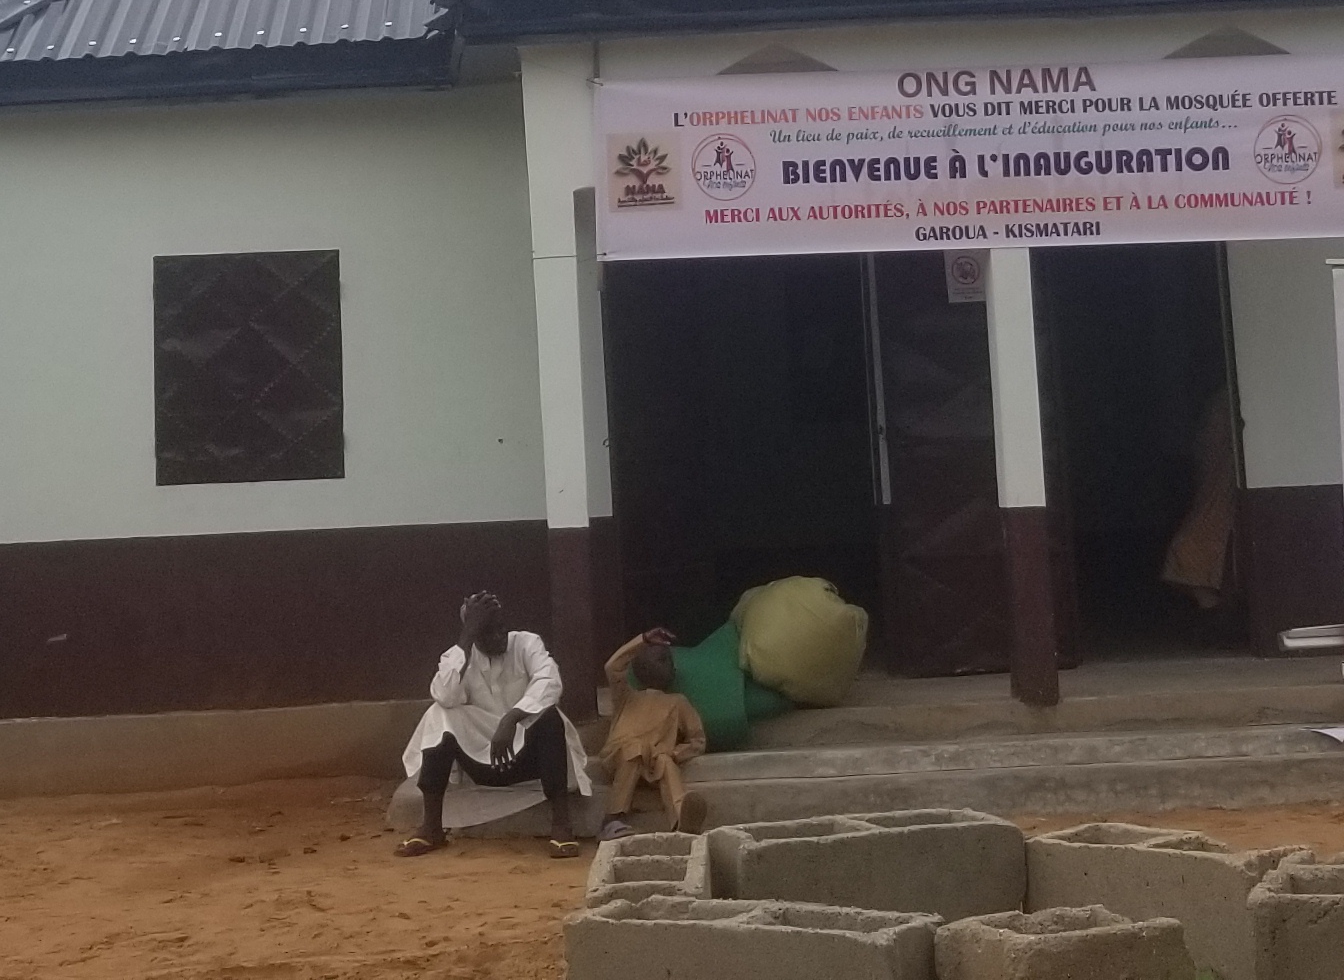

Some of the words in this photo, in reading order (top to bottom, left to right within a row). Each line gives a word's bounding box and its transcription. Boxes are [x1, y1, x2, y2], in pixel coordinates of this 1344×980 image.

[897, 70, 977, 98] ONG
[988, 66, 1097, 96] NAMA
[805, 106, 840, 123] NOS
[847, 104, 924, 121] ENFANTS
[929, 102, 977, 119] VOUS
[983, 101, 1013, 117] DIT
[1019, 98, 1075, 115] MERCI
[1082, 97, 1133, 114] POUR
[1138, 96, 1160, 112] LA
[1165, 89, 1253, 112] MOSQUÉE
[1258, 90, 1338, 108] OFFERTE
[769, 129, 791, 144] Un
[795, 128, 821, 143] lieu
[826, 127, 842, 142] de
[845, 127, 884, 145] paix,
[887, 125, 903, 139] de
[907, 122, 998, 139] recueillement
[1002, 122, 1014, 135] et
[1101, 121, 1136, 137] pour
[1139, 121, 1163, 131] nos
[781, 155, 939, 185] BIENVENUE
[948, 148, 967, 180] À
[1255, 151, 1318, 164] ORPHELINAT
[696, 169, 755, 181] ORPHELINAT
[624, 183, 666, 196] NAMA
[704, 206, 761, 225] MERCI
[767, 206, 802, 221] AUX
[807, 199, 910, 220] AUTORITÉS,
[916, 198, 928, 217] À
[933, 200, 970, 217] NOS
[975, 195, 1097, 215] PARTENAIRES
[1102, 195, 1124, 211] ET
[1129, 191, 1141, 211] À
[1147, 194, 1169, 210] LA
[1174, 186, 1300, 210] COMMUNAUTÉ
[1305, 190, 1312, 205] !
[914, 224, 989, 242] GAROUA
[1005, 220, 1102, 240] KISMATARI
